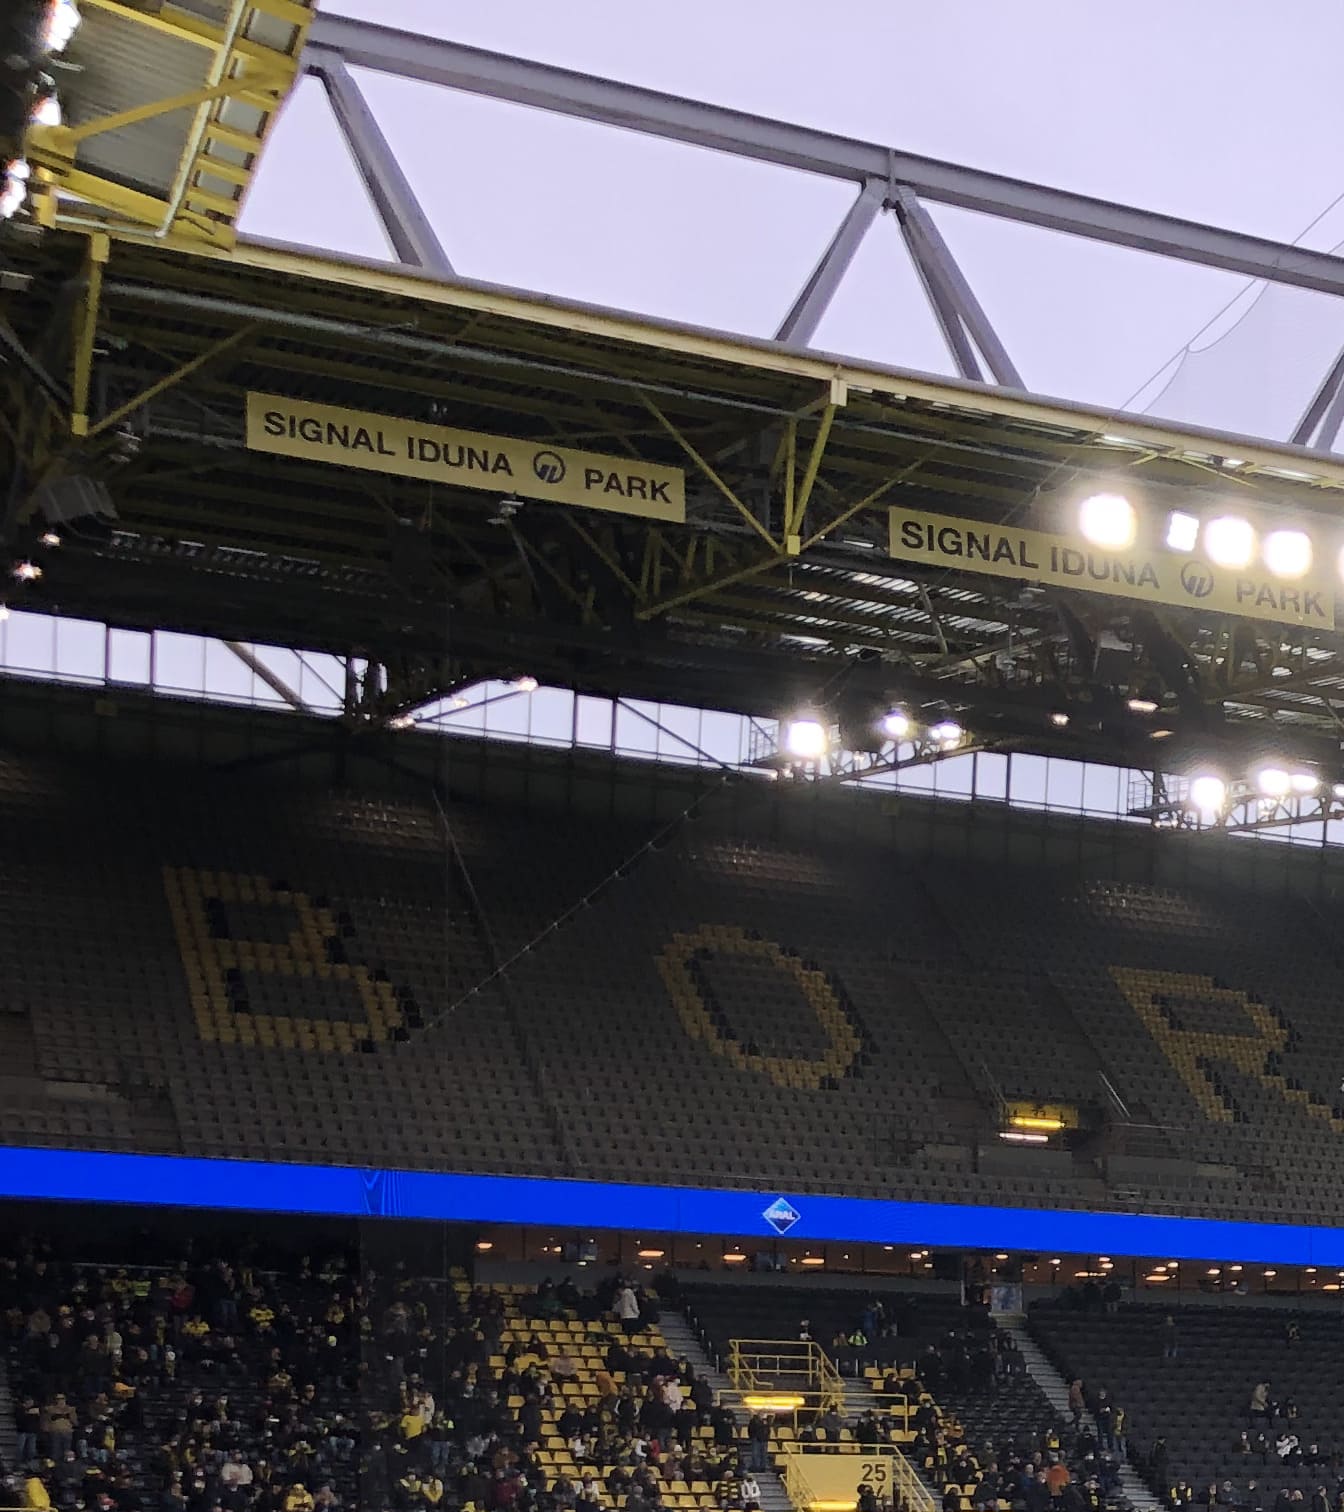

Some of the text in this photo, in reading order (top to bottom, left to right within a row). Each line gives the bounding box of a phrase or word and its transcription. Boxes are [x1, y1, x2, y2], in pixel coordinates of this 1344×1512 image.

[263, 411, 672, 504] SIGNAL IDUNA PARK
[901, 519, 1327, 618] SIGNAL IDUNA PARK
[862, 1464, 886, 1482] 25
